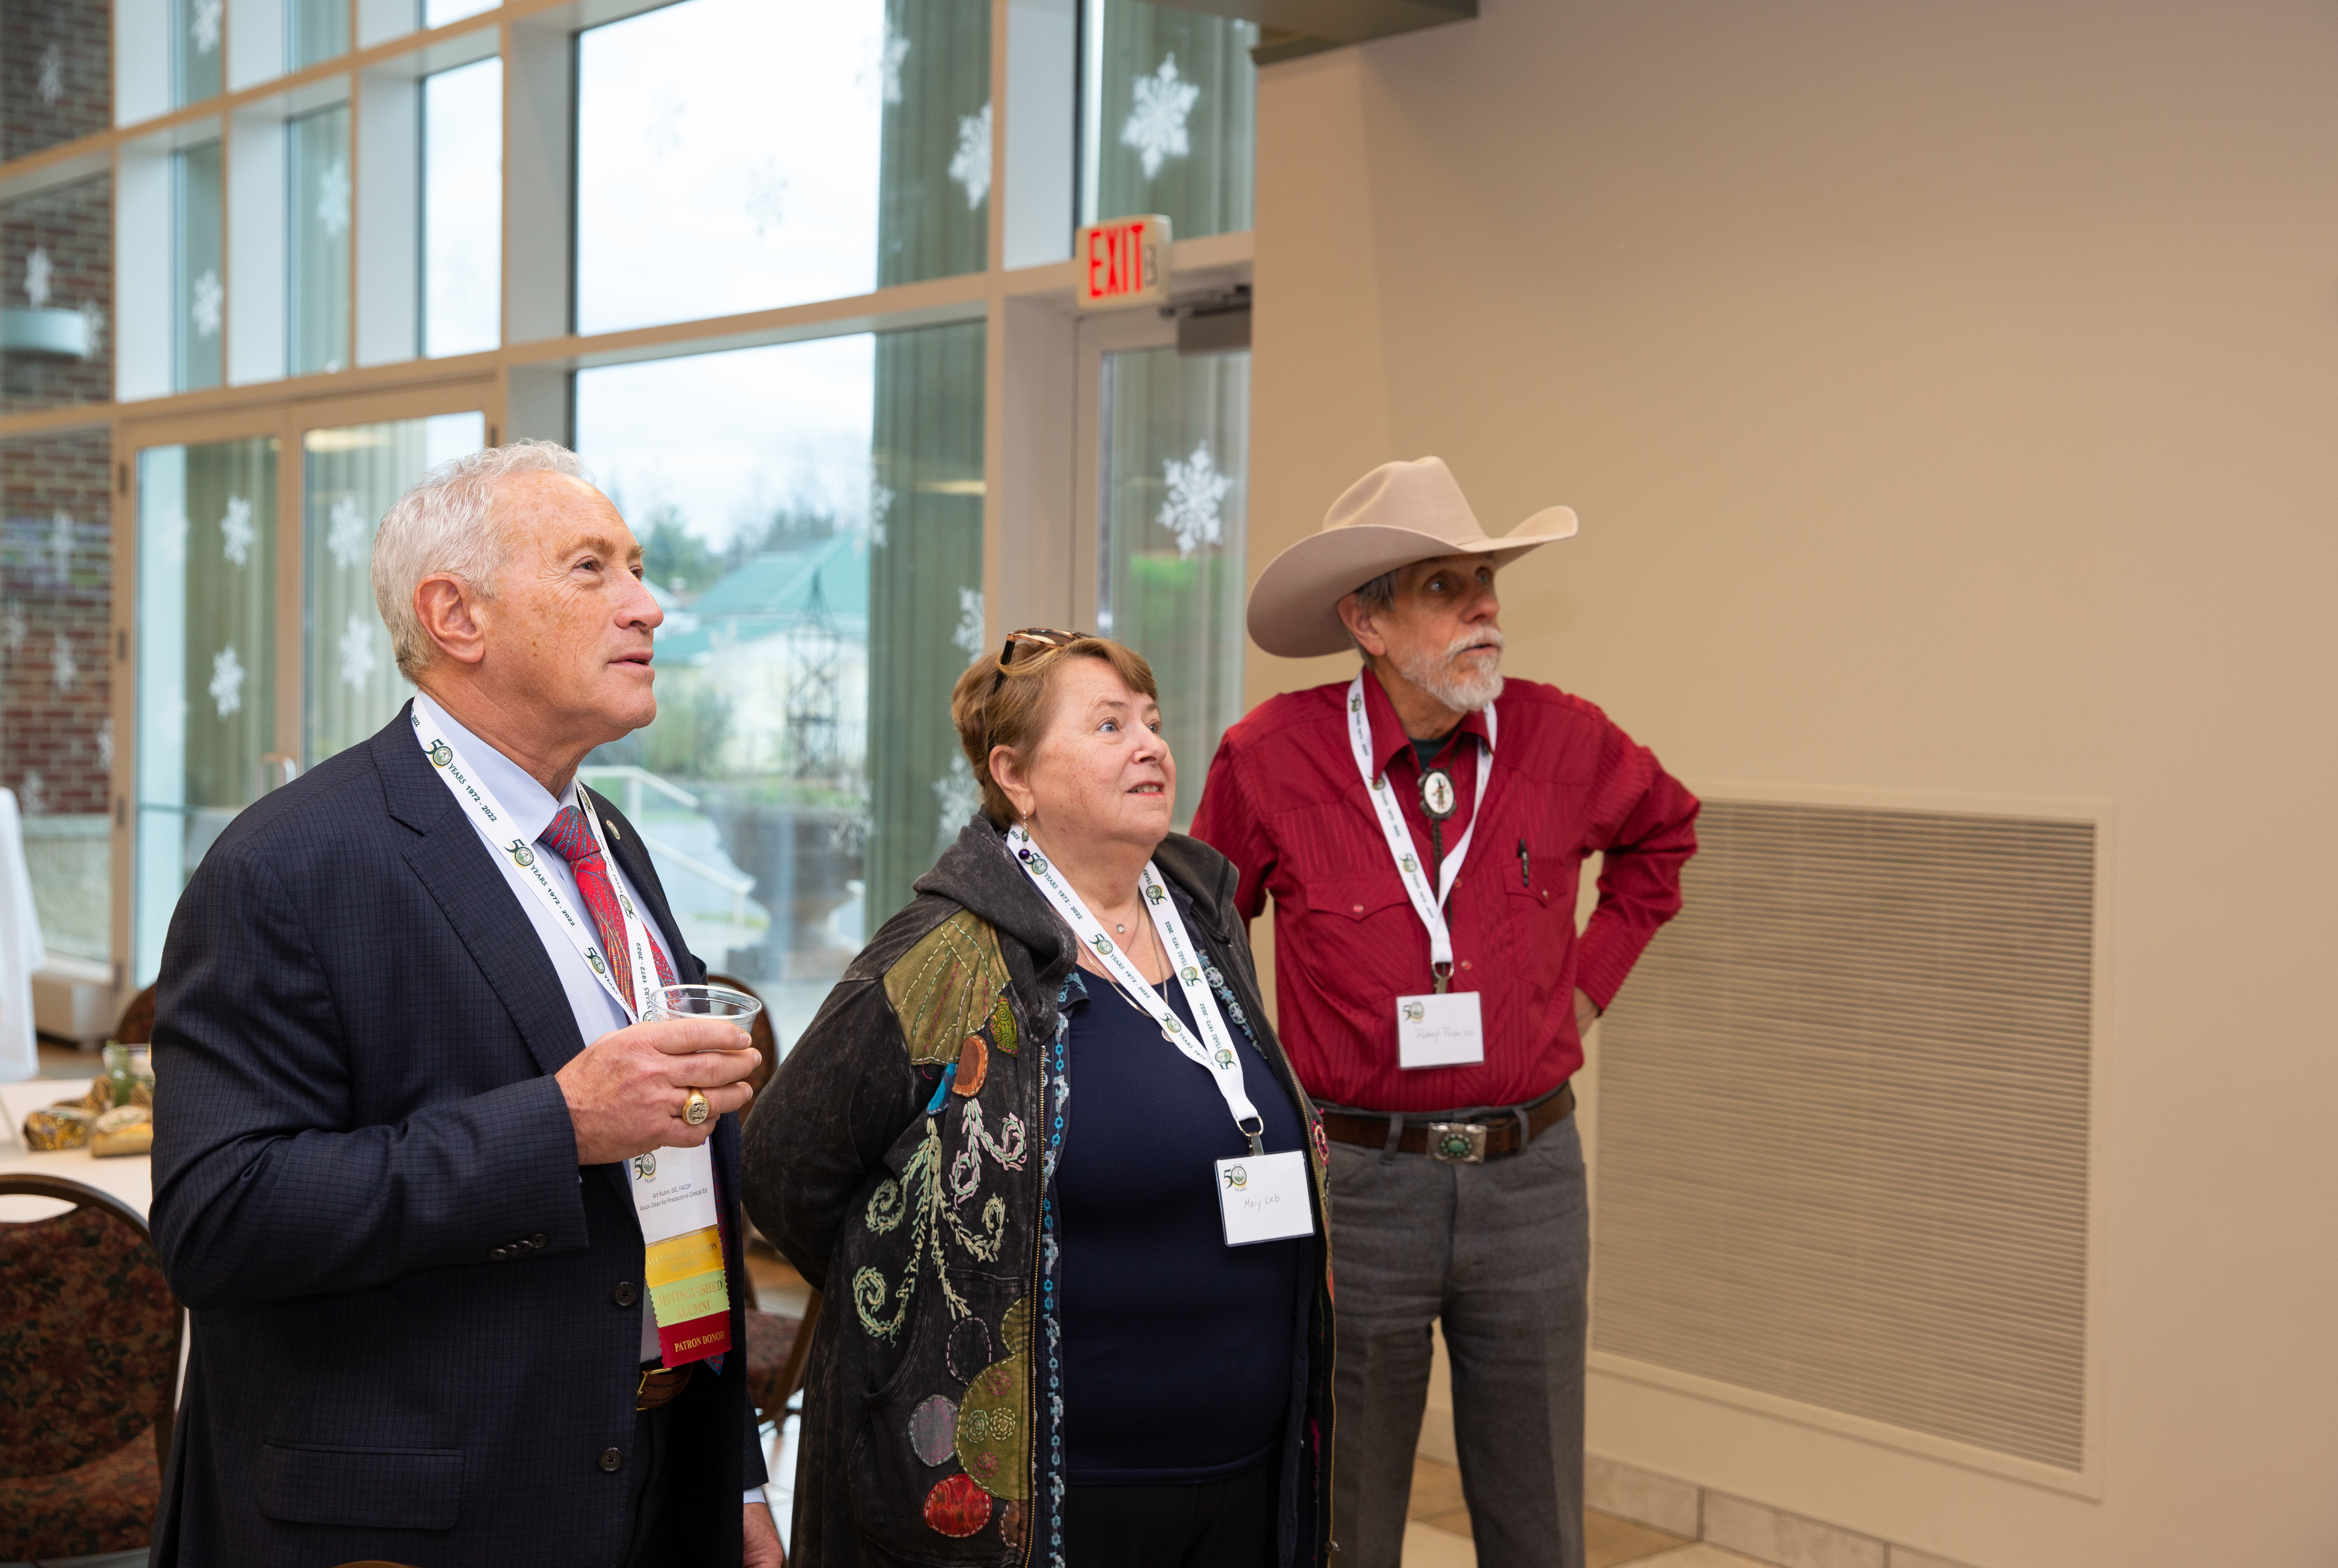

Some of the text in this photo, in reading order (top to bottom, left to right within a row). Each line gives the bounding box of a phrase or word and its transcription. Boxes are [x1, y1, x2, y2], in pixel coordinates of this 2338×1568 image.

[1087, 221, 1147, 300] EXIT
[412, 715, 420, 727] 2022
[424, 738, 453, 766] 50
[448, 763, 466, 784] YEARS
[466, 785, 480, 802] 1972
[482, 805, 497, 822] 2022
[504, 839, 534, 866] 50
[530, 864, 548, 886] YEARS
[547, 888, 561, 905] 1972
[562, 909, 575, 927] 2022
[1024, 853, 1048, 875] 50
[1044, 872, 1059, 889] YEARS
[1058, 890, 1070, 903] 1972
[1071, 906, 1082, 920] 2022
[1172, 937, 1180, 949] 1972
[1088, 934, 1113, 954] 50
[1110, 953, 1125, 970] YEARS
[1125, 971, 1136, 983] 1972
[1138, 986, 1151, 999] 2022
[1177, 951, 1188, 967] YEARS
[583, 947, 605, 974] 50
[604, 973, 618, 994] YEARS
[1200, 1003, 1208, 1016] 2022
[1403, 1001, 1424, 1021] 50
[1158, 1013, 1181, 1033] 50
[1180, 1032, 1193, 1049] YEARS
[1212, 1034, 1222, 1049] YEARS
[634, 1153, 656, 1180] 50
[679, 1183, 691, 1191] FACOP
[1224, 1166, 1247, 1188] 50
[667, 1193, 689, 1203] Predoctoral
[689, 1189, 702, 1197] Clinical
[1244, 1198, 1262, 1212] Mary
[675, 1242, 718, 1259] ASSOCIATION
[656, 1280, 723, 1307] DISTINGUISHED
[677, 1299, 711, 1319] ALUMNI
[674, 1331, 725, 1352] PATRON DONOR
